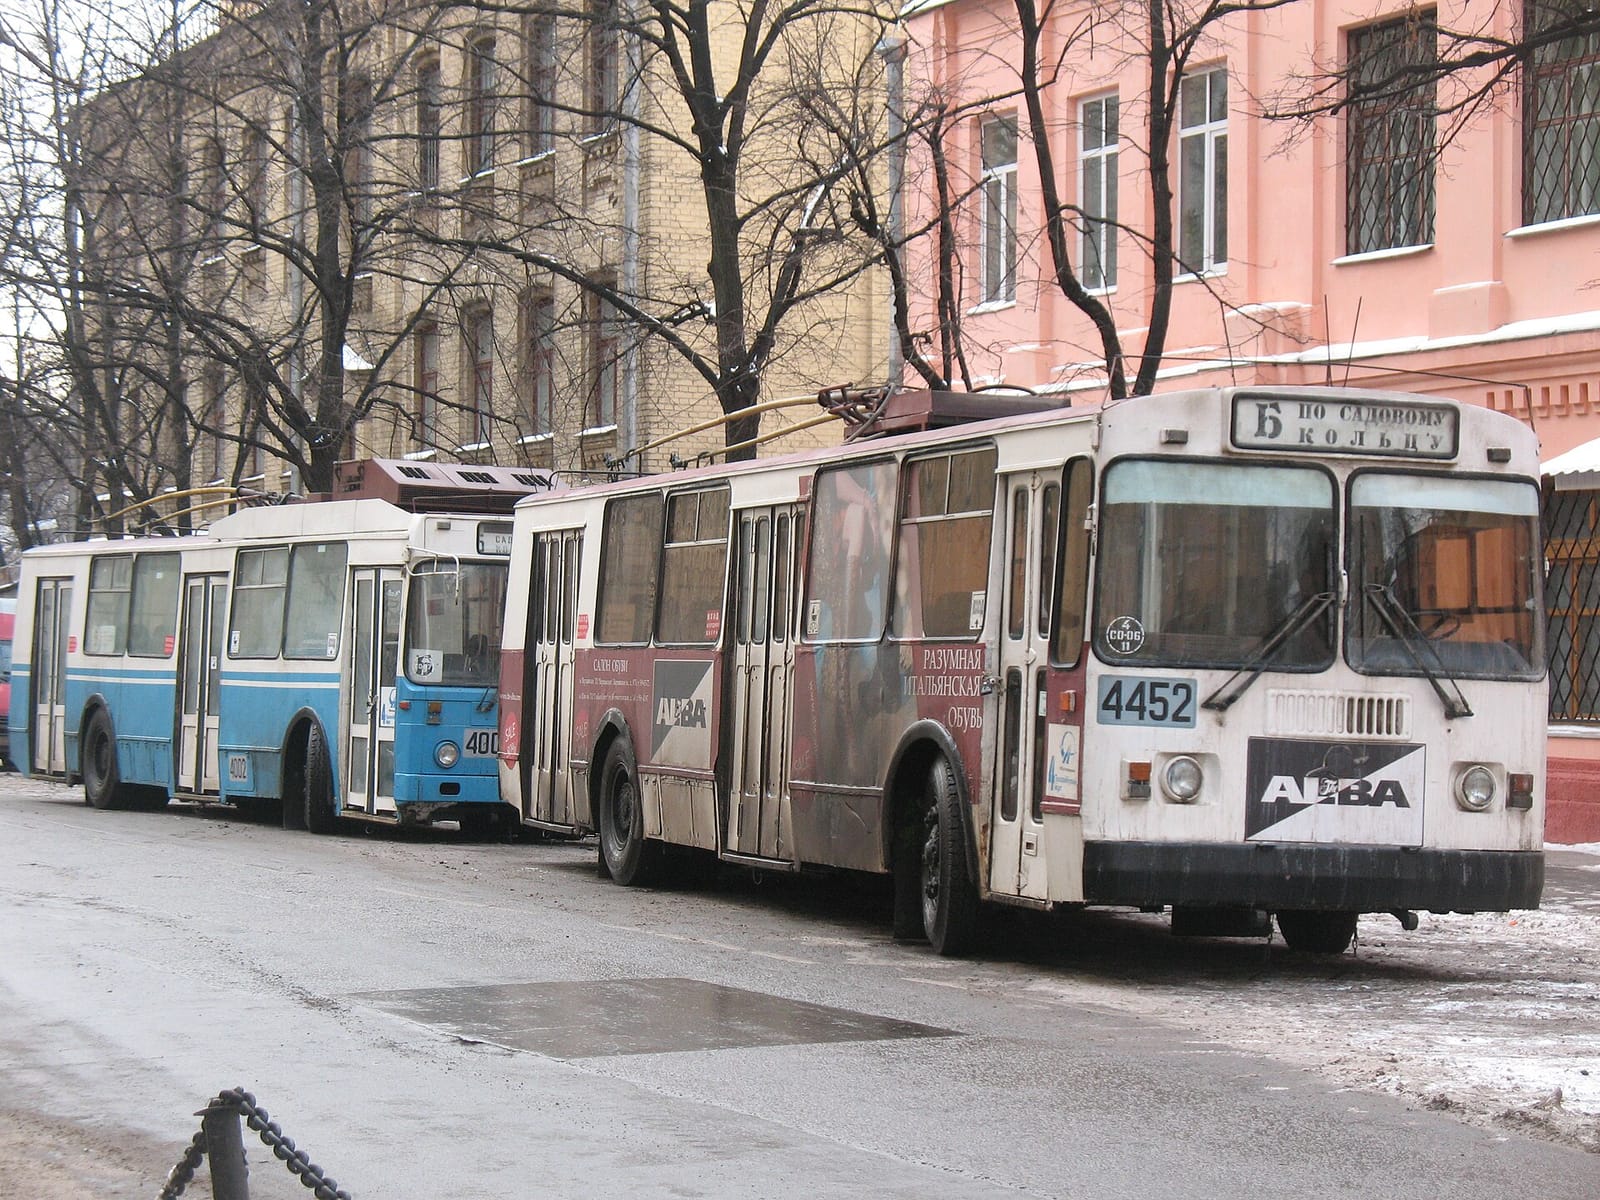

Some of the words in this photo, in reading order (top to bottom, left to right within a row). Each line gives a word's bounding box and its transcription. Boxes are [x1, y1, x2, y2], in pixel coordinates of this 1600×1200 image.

[1254, 402, 1282, 439] Б
[1299, 403, 1326, 420] ПО
[1340, 406, 1446, 426] САДОВОМУ
[1299, 428, 1444, 452] КОЛЬЦУ
[1121, 619, 1131, 630] 4
[1121, 641, 1130, 651] 11
[923, 649, 981, 674] РАЗУМНАЯ
[903, 675, 981, 697] ИТАЛЬЯНСКАЯ
[1101, 679, 1192, 723] 4452
[948, 706, 983, 733] ОБУВЬ
[230, 757, 247, 779] 4002
[1260, 776, 1411, 808] ALBA
